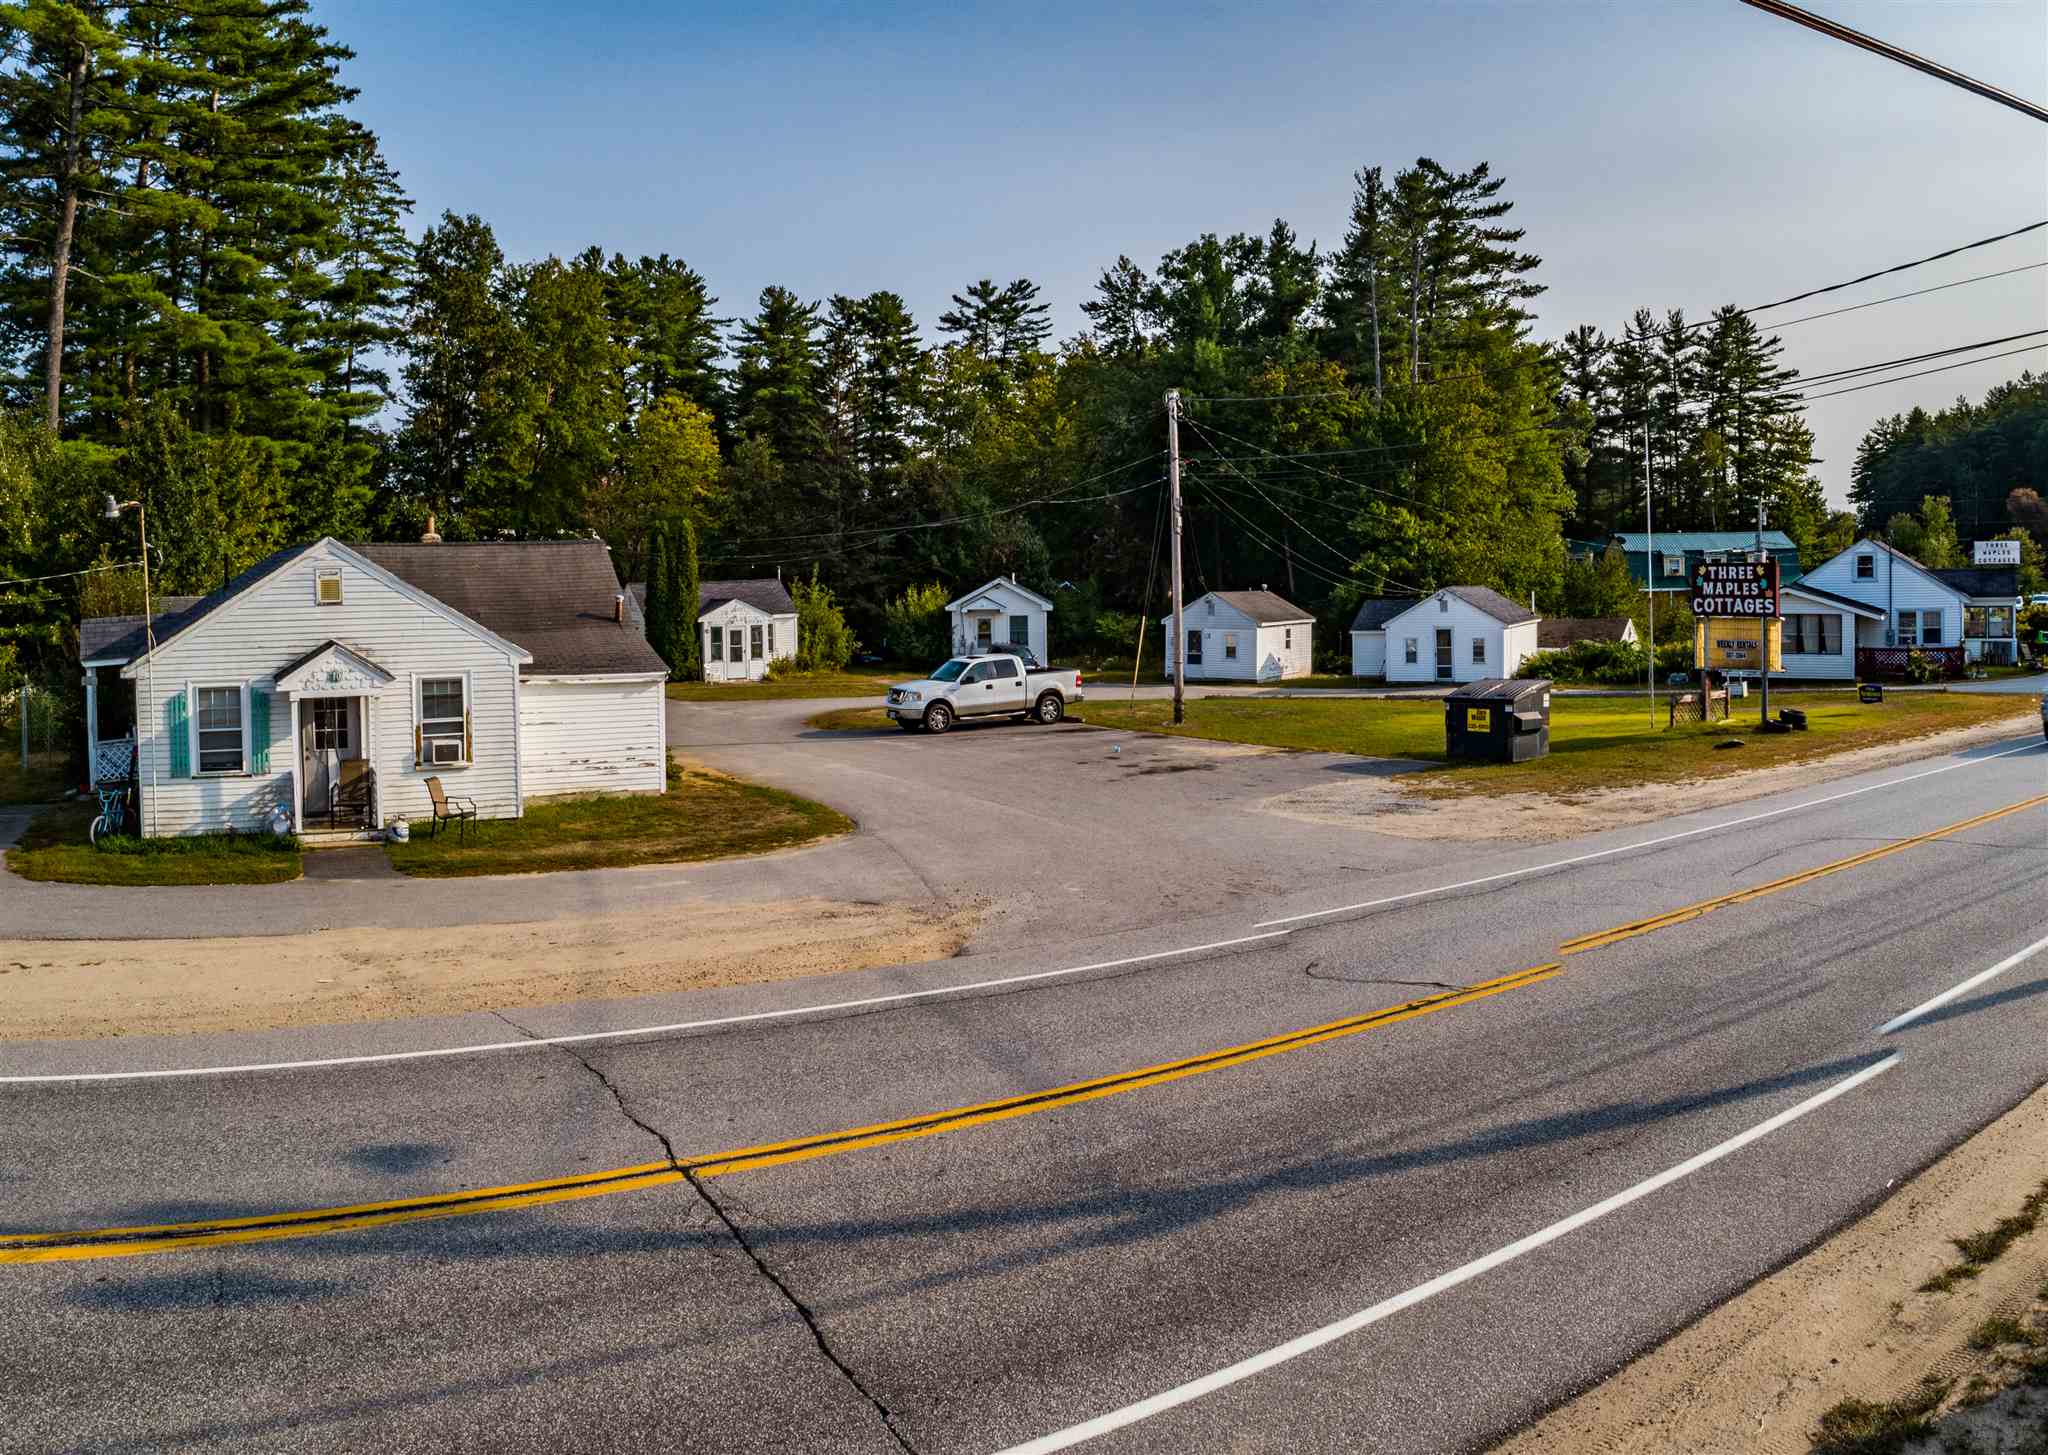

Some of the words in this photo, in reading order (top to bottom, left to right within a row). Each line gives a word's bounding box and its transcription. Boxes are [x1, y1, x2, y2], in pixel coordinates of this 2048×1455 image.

[1707, 566, 1754, 579] THREE
[1703, 582, 1759, 595] MAPLES
[1693, 598, 1775, 613] COTTAGES
